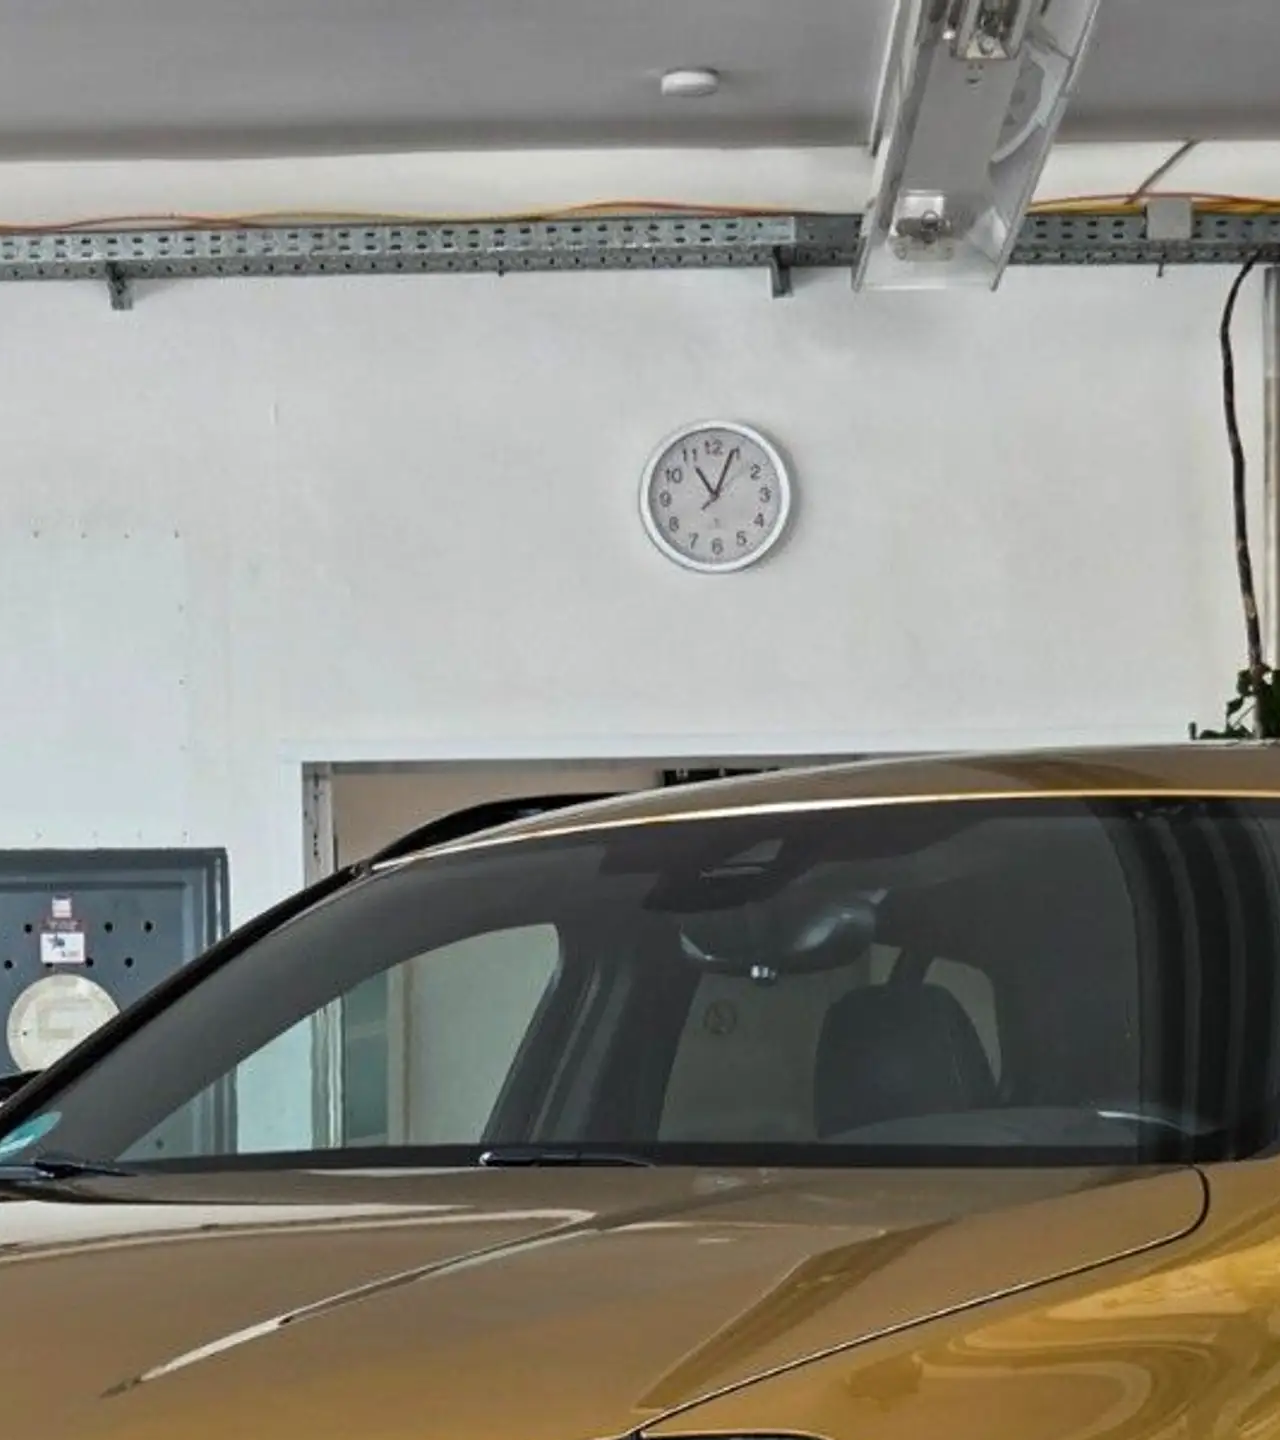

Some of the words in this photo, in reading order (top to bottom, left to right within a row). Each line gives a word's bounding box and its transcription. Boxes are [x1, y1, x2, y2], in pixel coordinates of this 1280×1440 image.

[682, 448, 698, 462] 11
[704, 440, 723, 456] 12
[666, 467, 683, 484] 10
[750, 463, 761, 480] 2
[659, 491, 672, 508] 9
[760, 487, 772, 503] 3
[669, 516, 679, 532] 8
[754, 512, 765, 528] 4
[689, 532, 699, 549] 7
[711, 538, 723, 555] 6
[736, 531, 747, 546] 5
